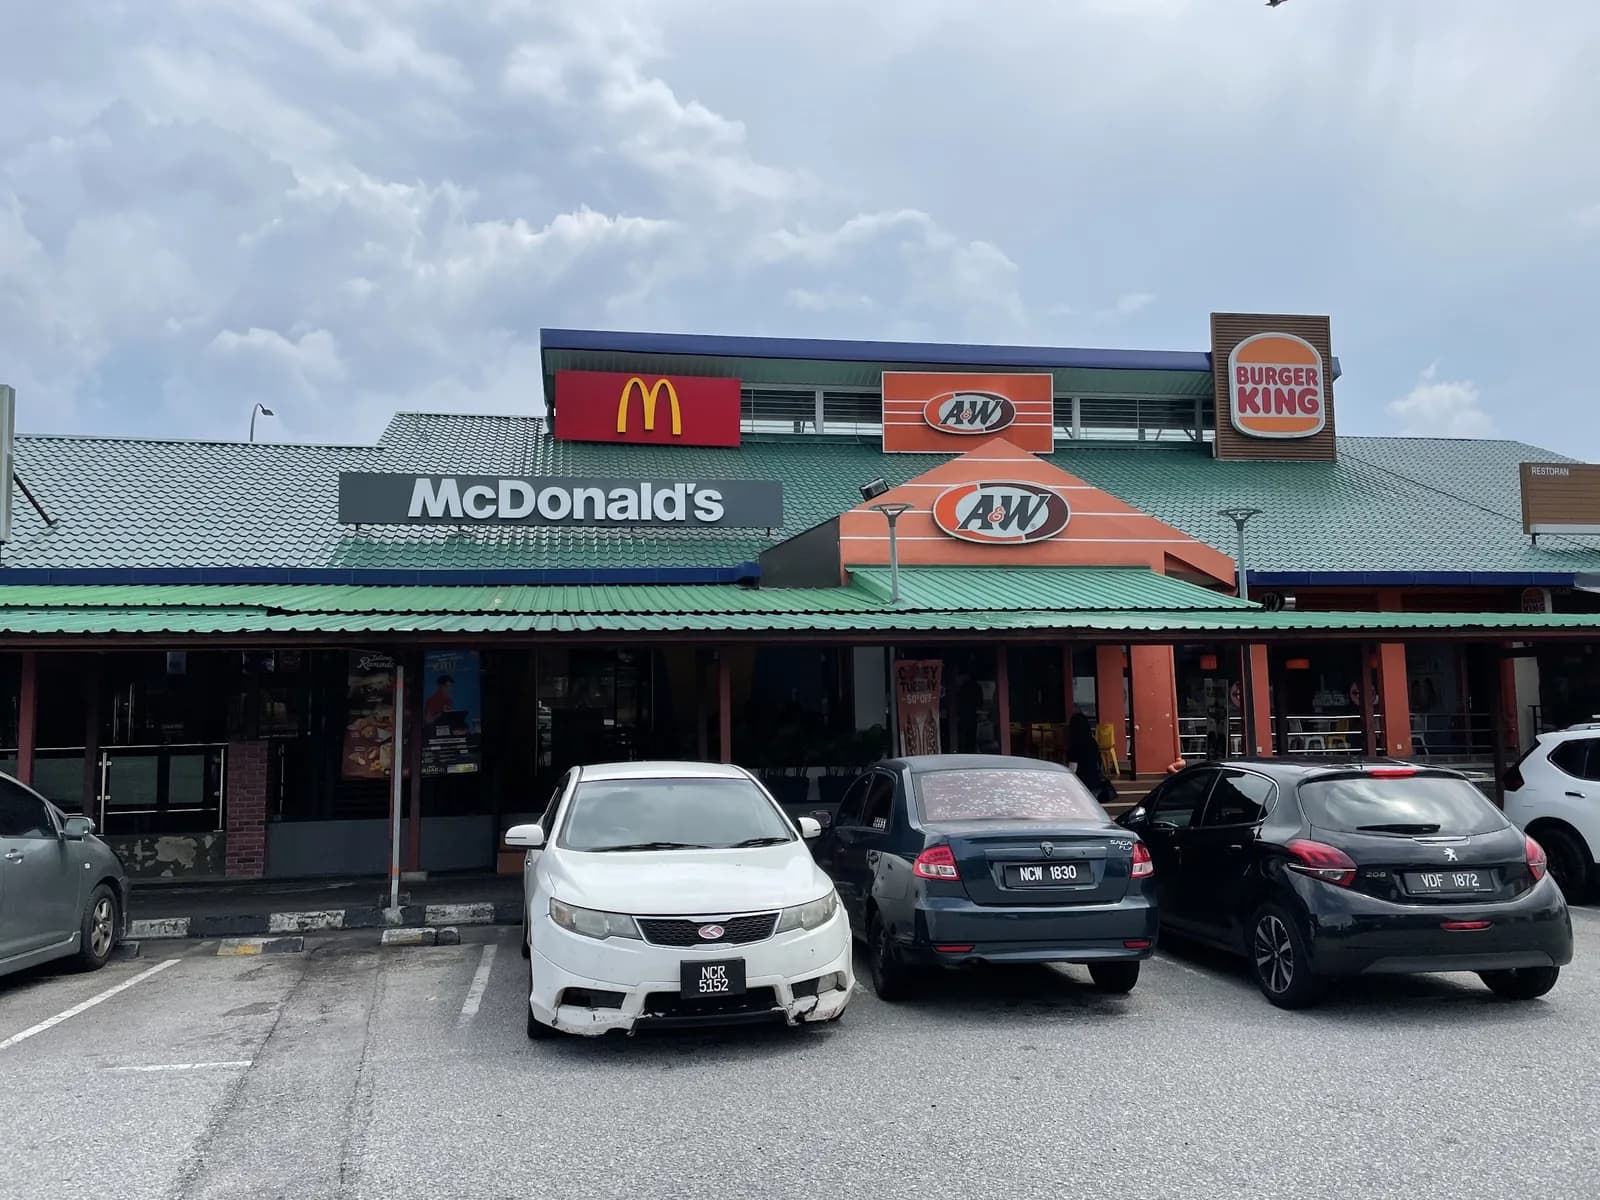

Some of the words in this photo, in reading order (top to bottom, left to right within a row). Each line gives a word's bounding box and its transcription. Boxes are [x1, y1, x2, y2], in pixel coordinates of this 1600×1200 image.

[1236, 366, 1319, 387] BURGER
[1237, 386, 1320, 415] KING
[940, 400, 1002, 426] A&W
[1531, 467, 1569, 476] RESTORAN
[407, 478, 725, 522] McDonald's
[956, 494, 1051, 532] A&W
[1020, 866, 1043, 881] NCW
[1050, 865, 1077, 880] 1830
[1420, 873, 1443, 888] VDF
[1452, 873, 1480, 887] 1872
[701, 965, 726, 980] NCR
[699, 978, 729, 993] 5152
